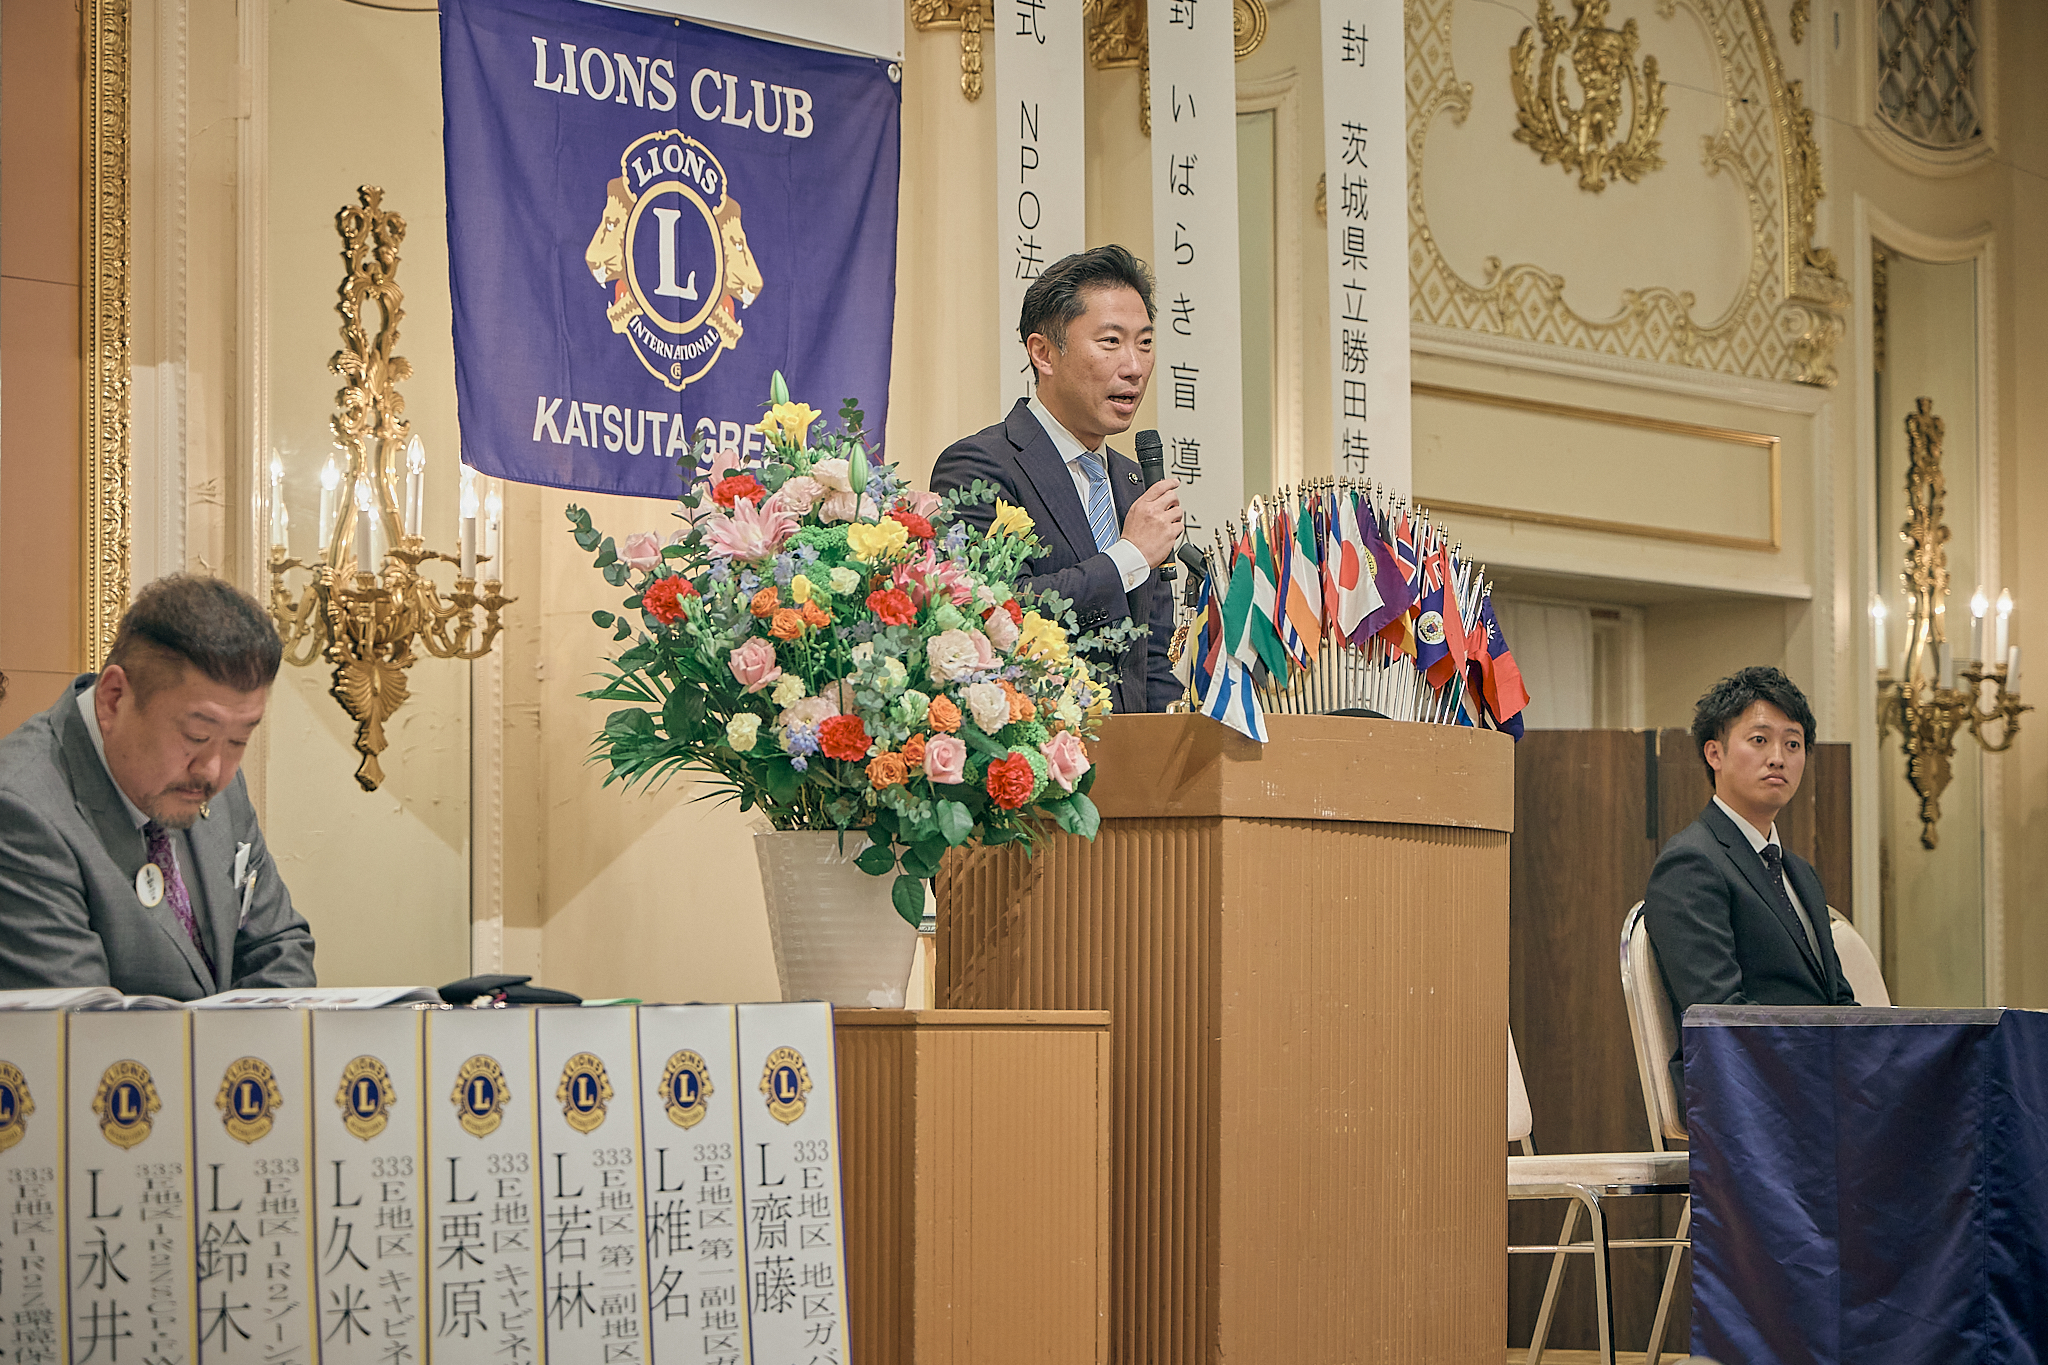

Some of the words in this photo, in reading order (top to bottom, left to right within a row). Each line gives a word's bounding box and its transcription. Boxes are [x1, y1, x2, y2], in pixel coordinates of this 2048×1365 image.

[1016, 0, 1046, 44] 式
[1341, 19, 1369, 67] 封
[531, 36, 676, 112] LIONS
[690, 67, 815, 139] CLUB
[631, 144, 719, 195] LIONS
[652, 207, 699, 301] L
[1341, 120, 1370, 474] 茨城県立勝田特
[629, 315, 720, 361] INTERNATIONAL
[532, 396, 688, 458] KATSUTA
[696, 417, 807, 469] GRE
[118, 1087, 138, 1118] L
[241, 1083, 260, 1115] L
[358, 1081, 376, 1112] L
[473, 1080, 491, 1109] L
[577, 1077, 595, 1107] L
[678, 1074, 695, 1102] L
[778, 1070, 795, 1098] L
[77, 1168, 133, 1365] L永井
[197, 1163, 252, 1353] L鈴木
[254, 1157, 302, 1365] 333E地区1R2ゾーン
[325, 1159, 371, 1345] L久米
[437, 1156, 487, 1338] L栗原
[545, 1152, 596, 1331] L若林
[647, 1147, 694, 1322] L椎名
[494, 1264, 533, 1365] キャビネ
